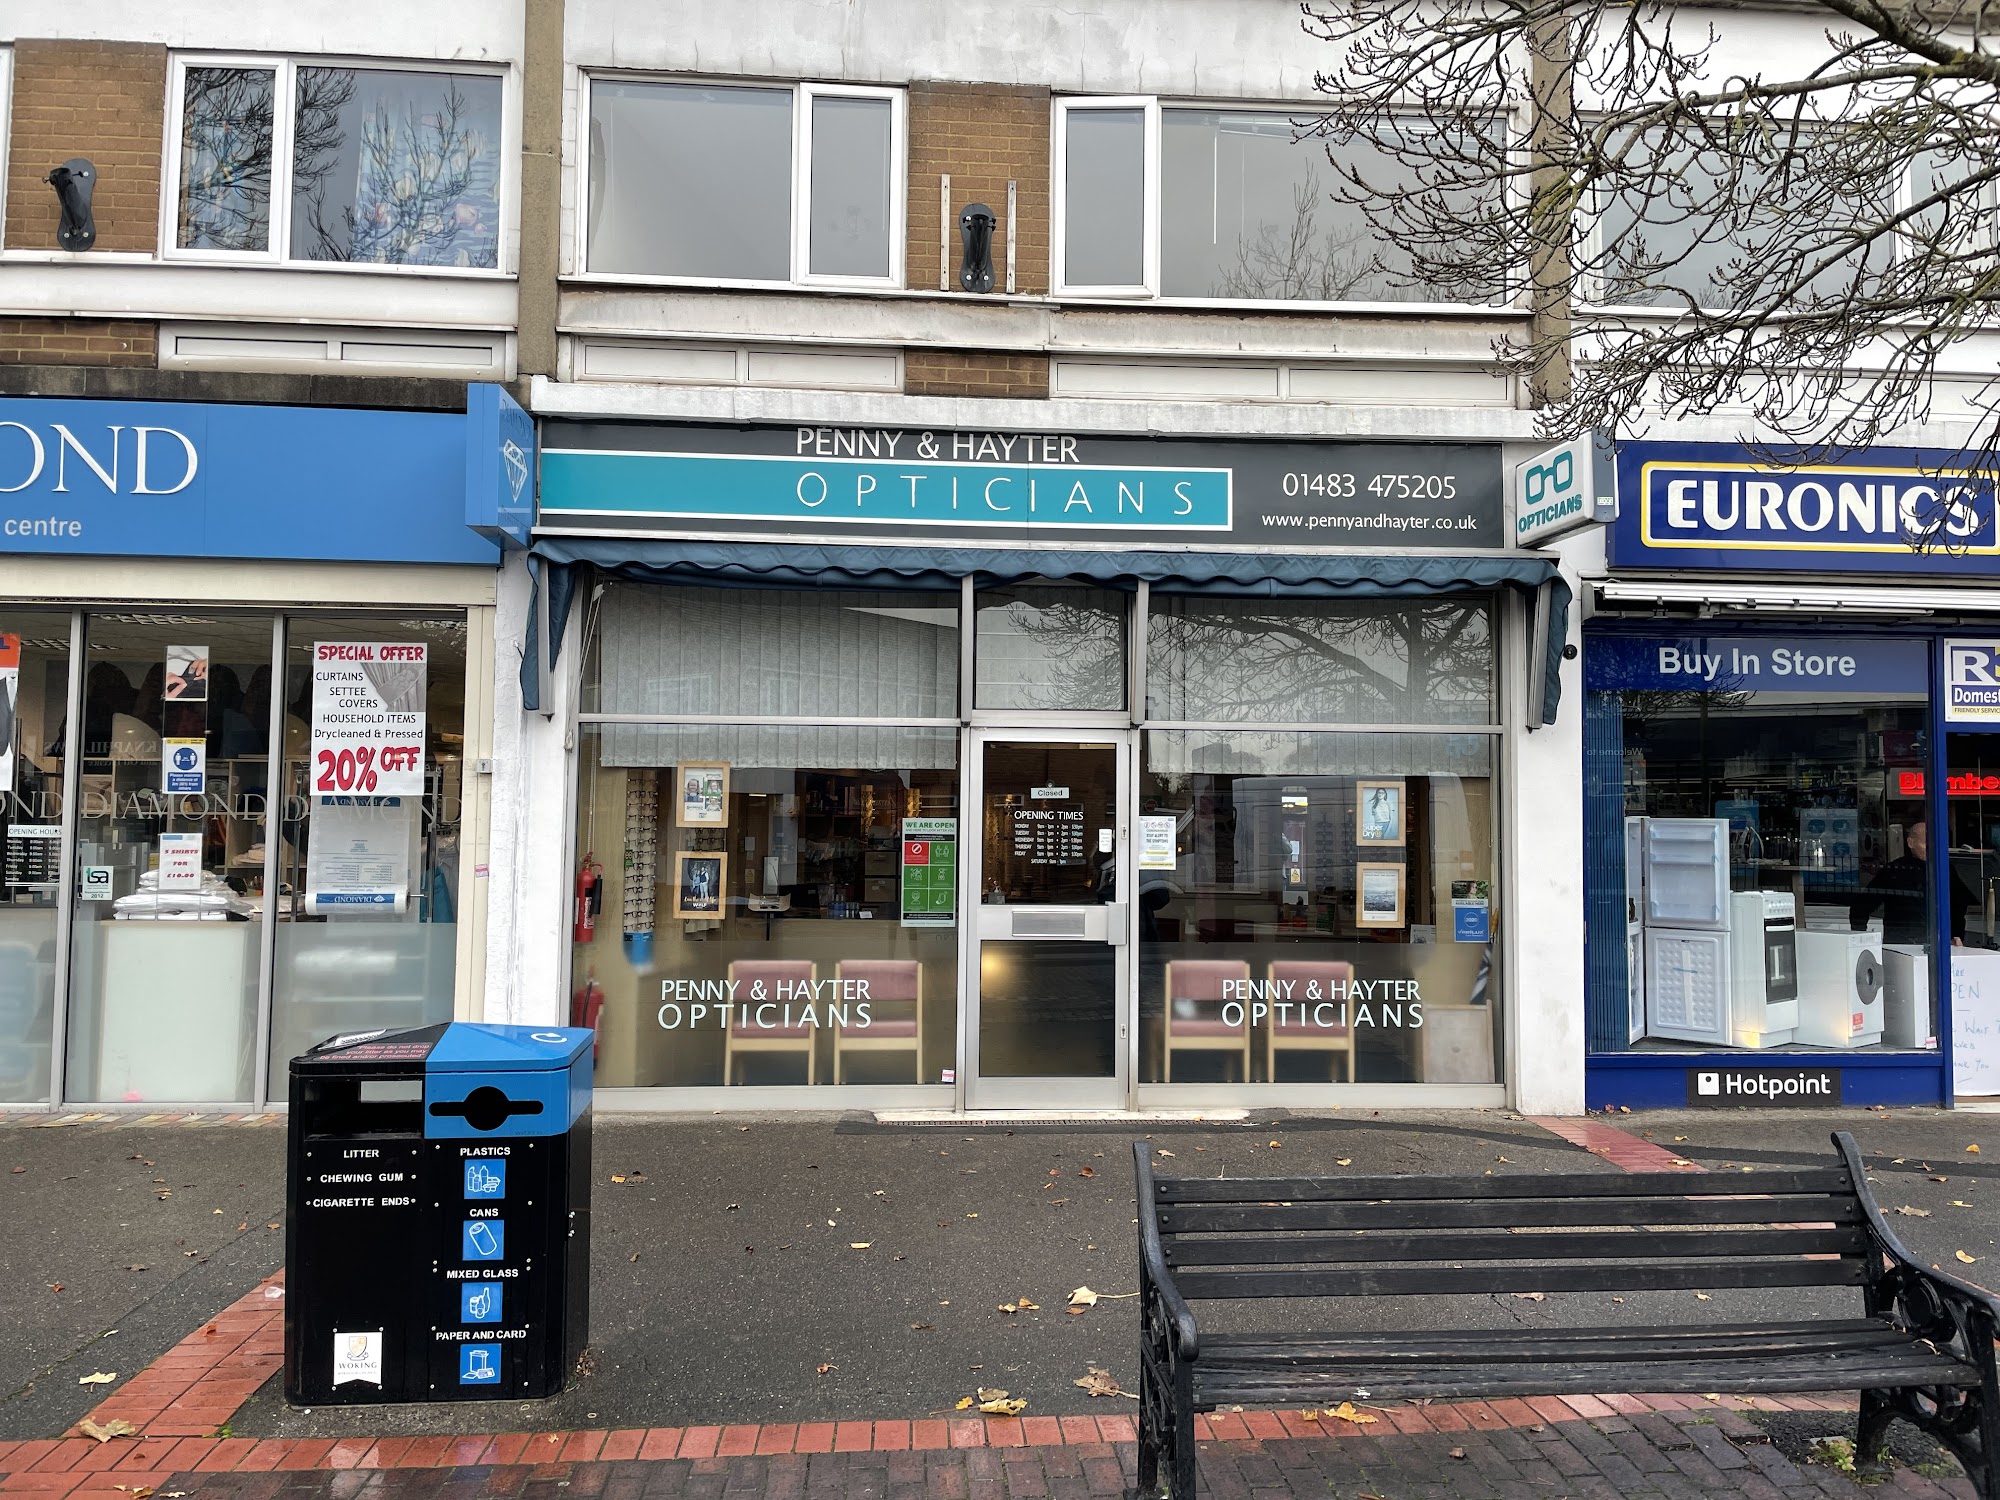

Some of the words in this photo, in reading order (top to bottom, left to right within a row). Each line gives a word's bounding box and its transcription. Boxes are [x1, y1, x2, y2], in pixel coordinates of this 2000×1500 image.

[797, 427, 903, 458] PENNY
[917, 432, 940, 460] &
[953, 433, 1080, 463] HAYTER
[797, 472, 1193, 516] OPTICIANS
[1282, 472, 1356, 498] 01483
[1367, 473, 1456, 500] 475205
[1518, 493, 1583, 533] OPTICIANS
[1667, 479, 1980, 537] EURONICS
[4, 515, 82, 537] centre
[1262, 513, 1478, 531] www.pennyandhayter.co.uk
[318, 645, 374, 661] SPECIAL
[380, 646, 424, 661] OFFER
[1659, 647, 1722, 681] Buy
[1732, 648, 1760, 676] In
[1771, 648, 1857, 676] Store
[316, 672, 363, 681] CURTAINS
[329, 687, 366, 696] SETTEE
[339, 699, 378, 708] COVERS
[323, 714, 384, 723] HOUSEHOLD
[387, 714, 416, 724] ITEMS
[315, 729, 371, 740] Drycleaned
[374, 729, 381, 738] &
[385, 729, 423, 739] Pressed
[317, 746, 378, 792] 20%
[380, 746, 420, 771] OFF
[0, 791, 62, 818] ND
[83, 791, 267, 821] DIAMOND
[284, 795, 462, 825] DAMOND
[1014, 810, 1054, 820] OPENING
[1057, 811, 1084, 820] TIMES
[661, 979, 741, 1000] PENNY
[750, 979, 768, 1000] &
[777, 980, 871, 1000] HAYTER
[1222, 980, 1296, 1000] PENNY
[1306, 980, 1323, 1000] &
[1331, 980, 1421, 1001] HAYTER
[1952, 981, 1979, 998] PEN
[658, 1004, 872, 1029] OPTICIANS
[1221, 1002, 1424, 1028] OPTICIANS
[1726, 1073, 1831, 1100] Hotpoint
[343, 1149, 379, 1158] LITTER
[460, 1147, 511, 1156] PLASTICS
[320, 1174, 373, 1183] CHEWING
[378, 1173, 403, 1181] GUM
[313, 1198, 374, 1207] CIGARETTE
[381, 1197, 410, 1206] ENDS
[469, 1208, 499, 1217] CANS
[446, 1269, 479, 1278] MIXED
[482, 1269, 519, 1278] GLASS
[436, 1331, 470, 1340] PAPER
[472, 1331, 494, 1340] AND
[496, 1330, 526, 1339] CARD
